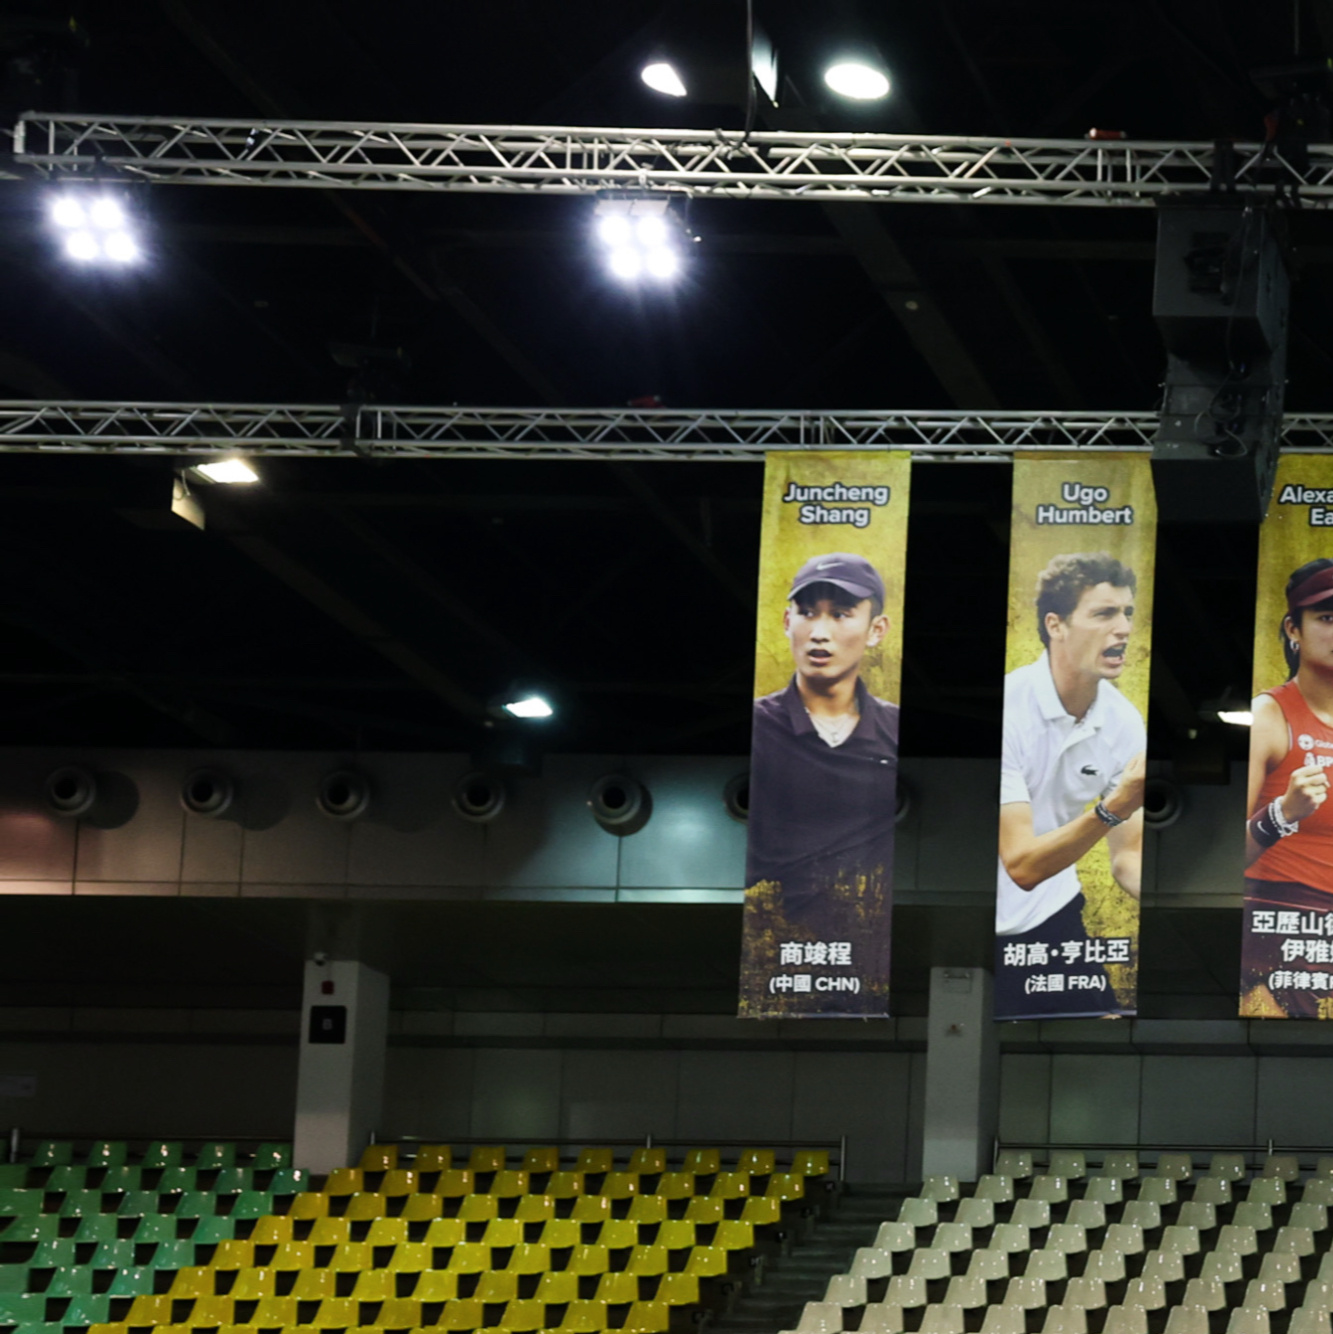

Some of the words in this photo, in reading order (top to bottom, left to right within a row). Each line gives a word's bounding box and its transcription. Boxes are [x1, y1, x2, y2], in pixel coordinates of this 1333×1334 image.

[785, 483, 889, 507] Juncheng
[1063, 483, 1109, 506] Ugo
[801, 505, 869, 528] Shang
[1037, 505, 1132, 526] Humbert
[780, 941, 851, 966] 商竣程
[769, 974, 811, 994] (中國
[815, 976, 861, 995] CHN)
[1024, 974, 1063, 994] (法國
[1067, 975, 1106, 993] FRA)
